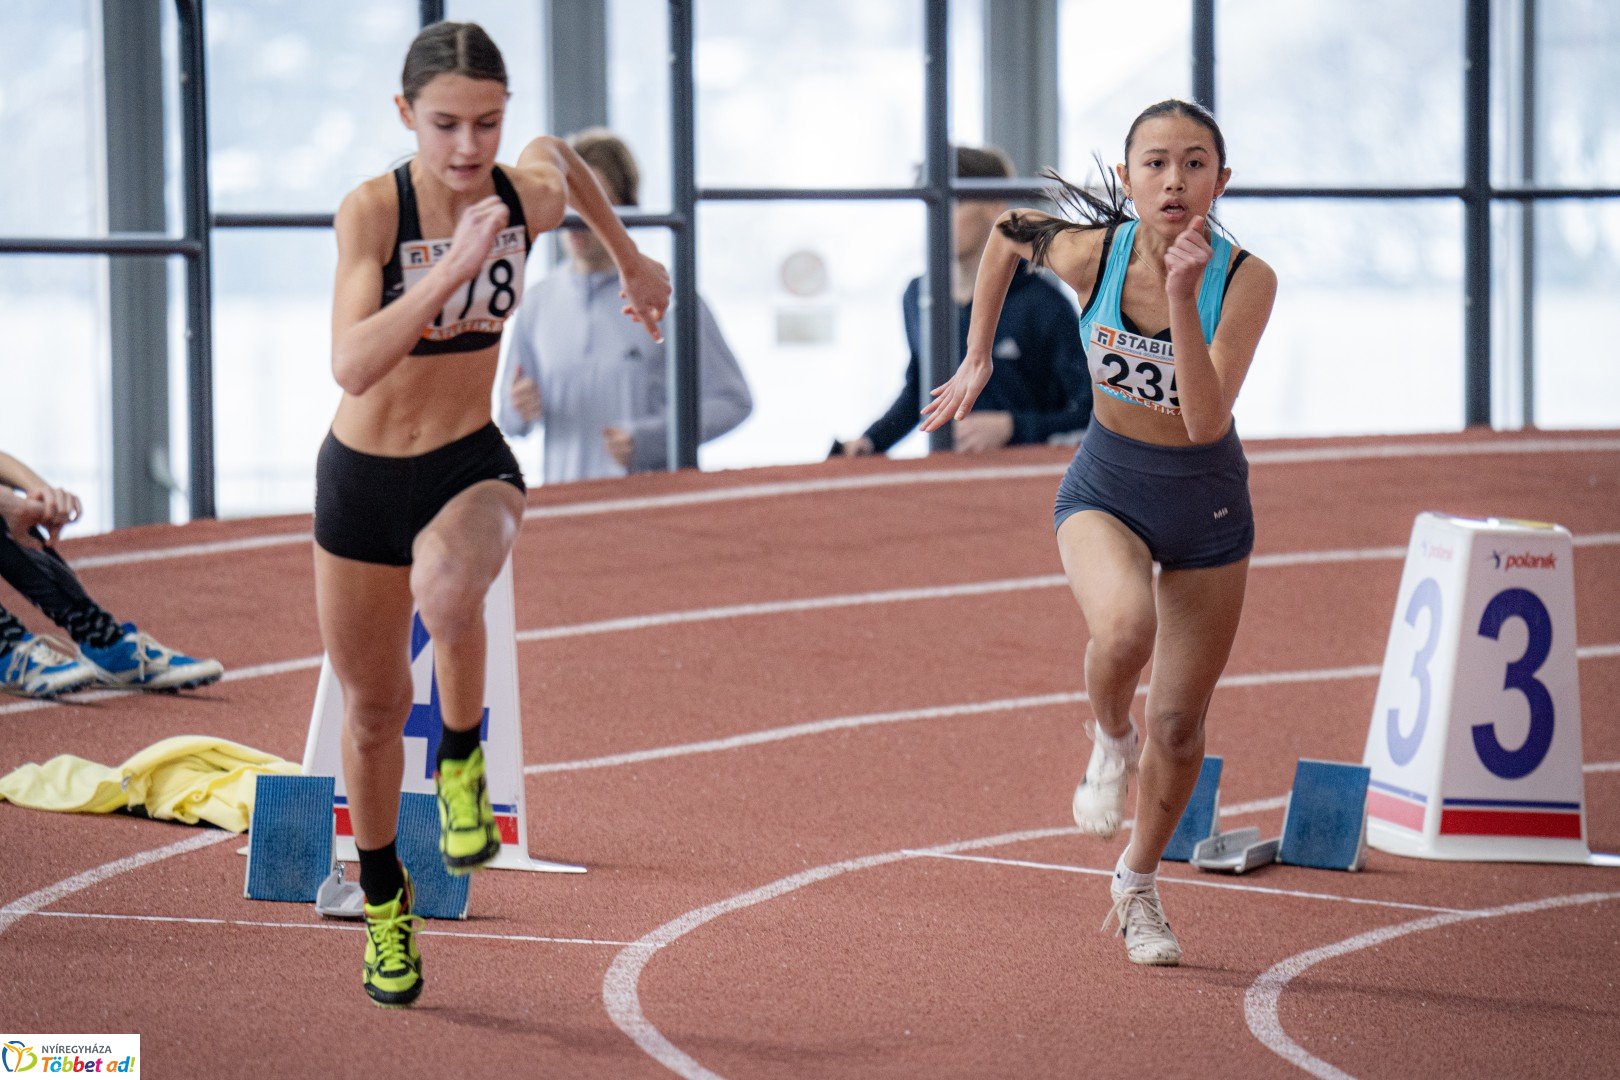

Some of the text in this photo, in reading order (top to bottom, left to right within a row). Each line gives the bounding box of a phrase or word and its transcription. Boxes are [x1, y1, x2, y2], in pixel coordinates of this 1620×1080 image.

[433, 259, 515, 327] 78
[1505, 550, 1557, 571] polanik
[1387, 577, 1443, 767] 3
[1471, 587, 1555, 780] 3
